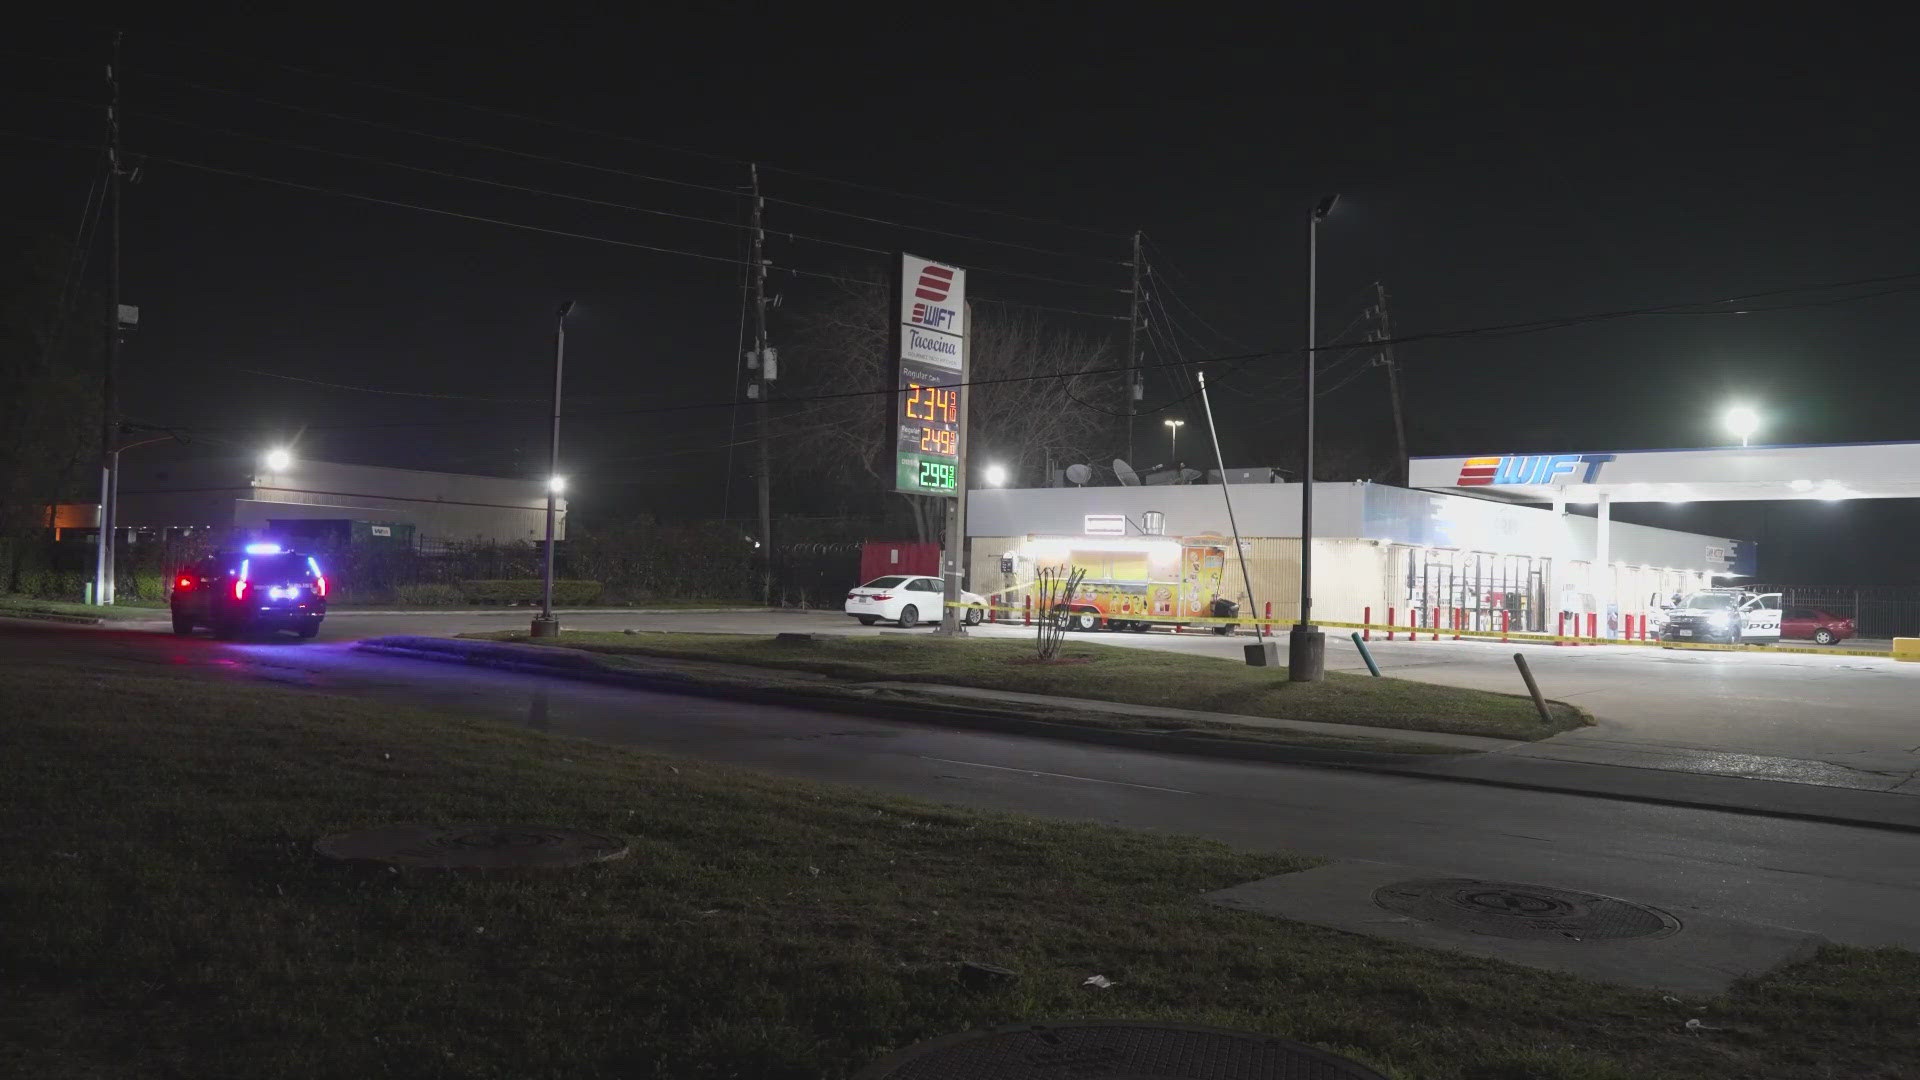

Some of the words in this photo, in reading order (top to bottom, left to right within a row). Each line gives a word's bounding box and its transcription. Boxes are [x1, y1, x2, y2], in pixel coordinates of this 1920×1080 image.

[909, 329, 956, 355] Tacocina
[903, 367, 928, 379] Regular
[907, 383, 948, 422] 2.34
[921, 428, 949, 454] 2.49
[920, 462, 949, 488] 2.99
[1457, 455, 1617, 486] SWIFT
